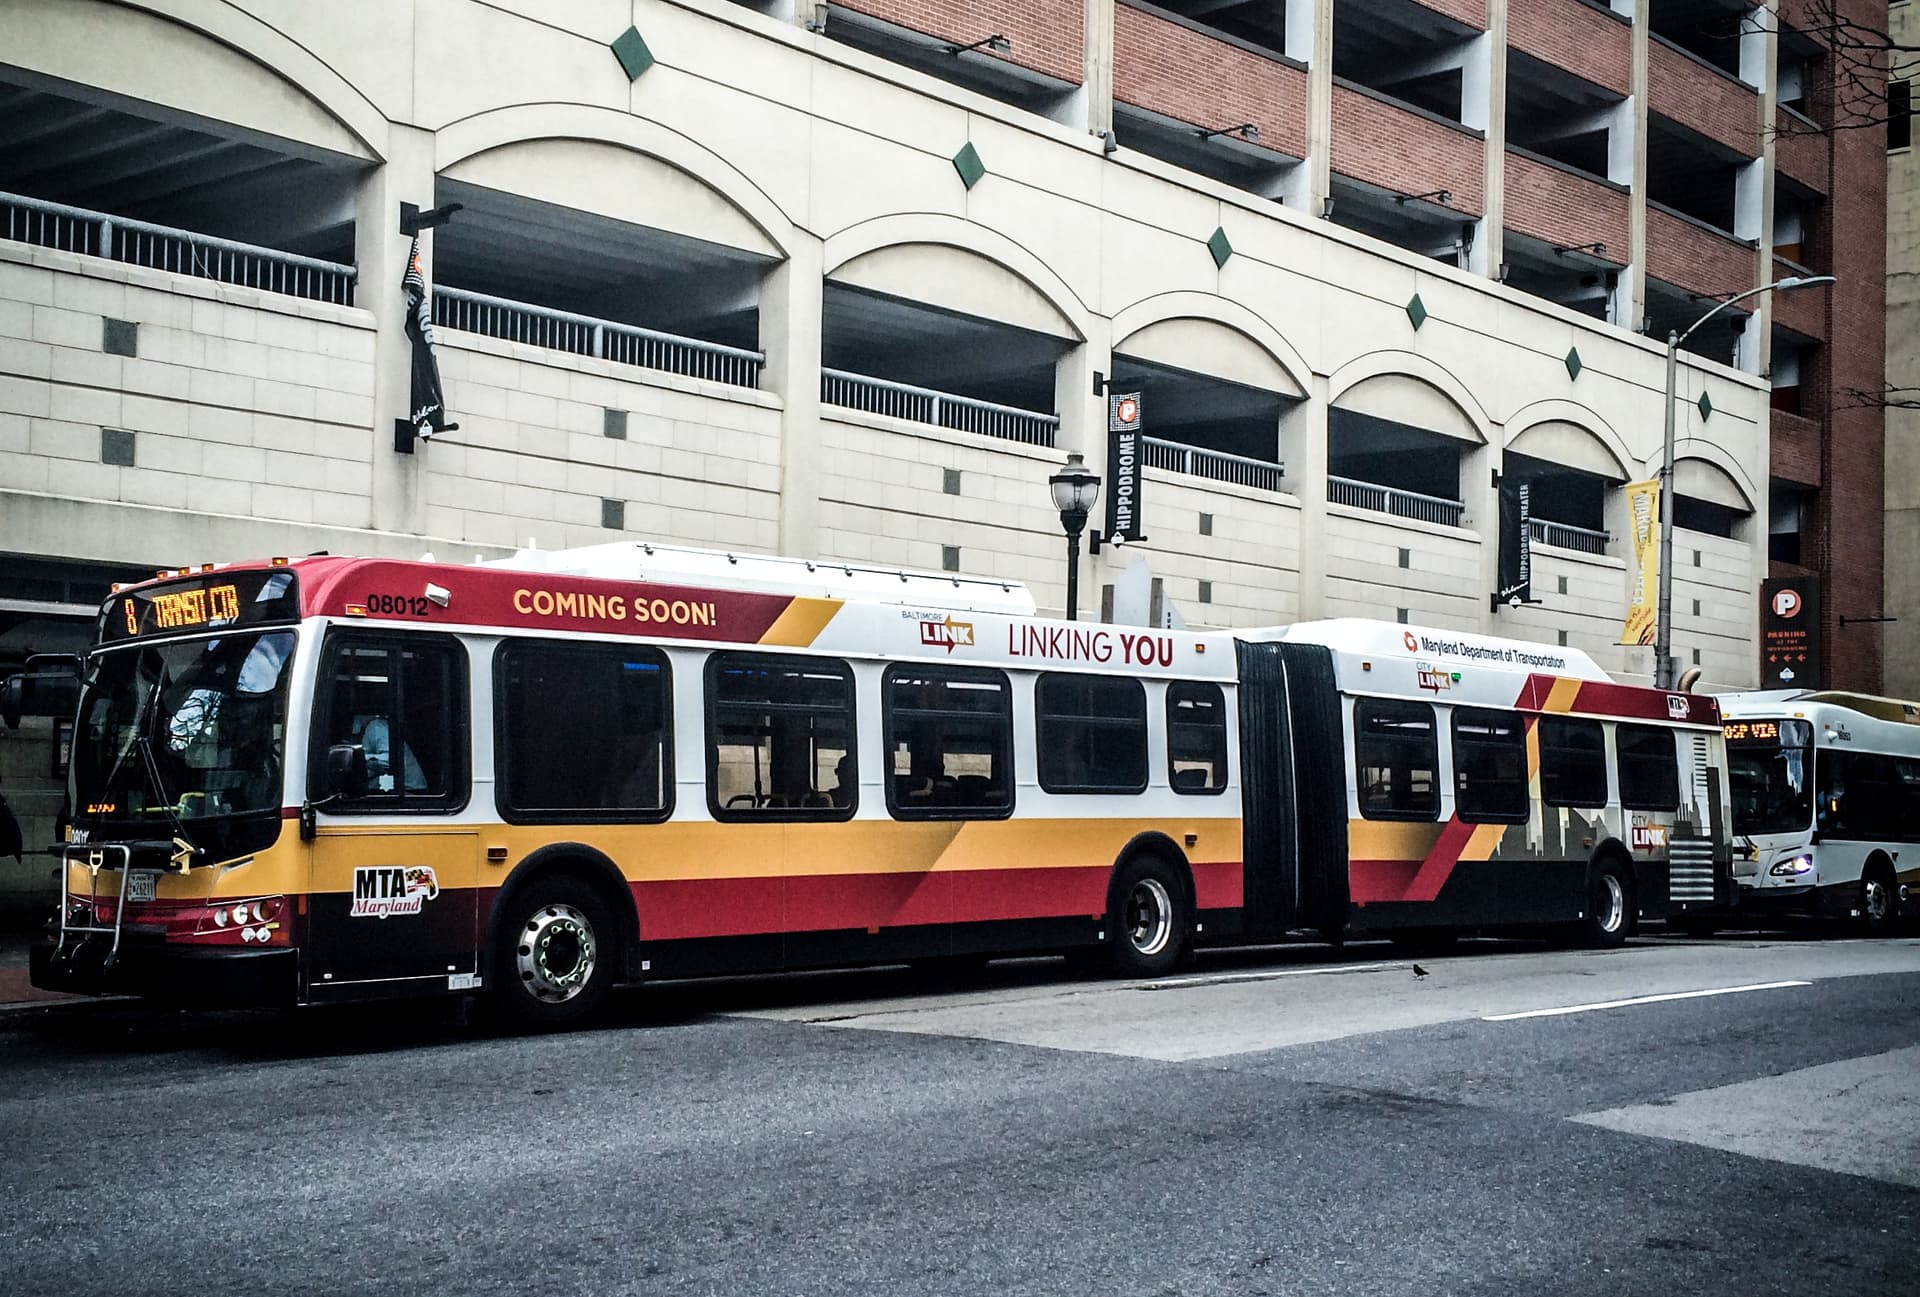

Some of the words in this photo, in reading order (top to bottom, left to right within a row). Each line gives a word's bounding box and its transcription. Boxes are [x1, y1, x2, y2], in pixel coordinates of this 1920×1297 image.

[1116, 433, 1135, 530] HIPPODROME
[1520, 484, 1529, 520] THEATER
[1520, 522, 1529, 580] HIPPODROME
[124, 599, 138, 635] 8
[152, 590, 207, 628] TRANSIT
[209, 585, 239, 619] CTR
[367, 594, 428, 616] 08012
[513, 588, 627, 620] COMING
[634, 597, 716, 626] SOON!
[1777, 594, 1796, 615] P
[902, 610, 943, 622] BALTIMORE
[922, 623, 974, 645] LINK
[1008, 623, 1112, 663] LINKING
[1120, 633, 1173, 667] YOU
[1421, 636, 1458, 657] Maryland
[1459, 642, 1503, 662] Department
[1504, 652, 1512, 662] of
[1512, 649, 1566, 670] Transportation
[1416, 661, 1431, 671] CITY
[1419, 674, 1450, 689] LINK
[1751, 723, 1777, 739] VIA
[1631, 815, 1647, 826] CITY
[1633, 828, 1666, 846] LINK
[356, 869, 406, 899] MTA
[354, 898, 421, 914] Maryland
